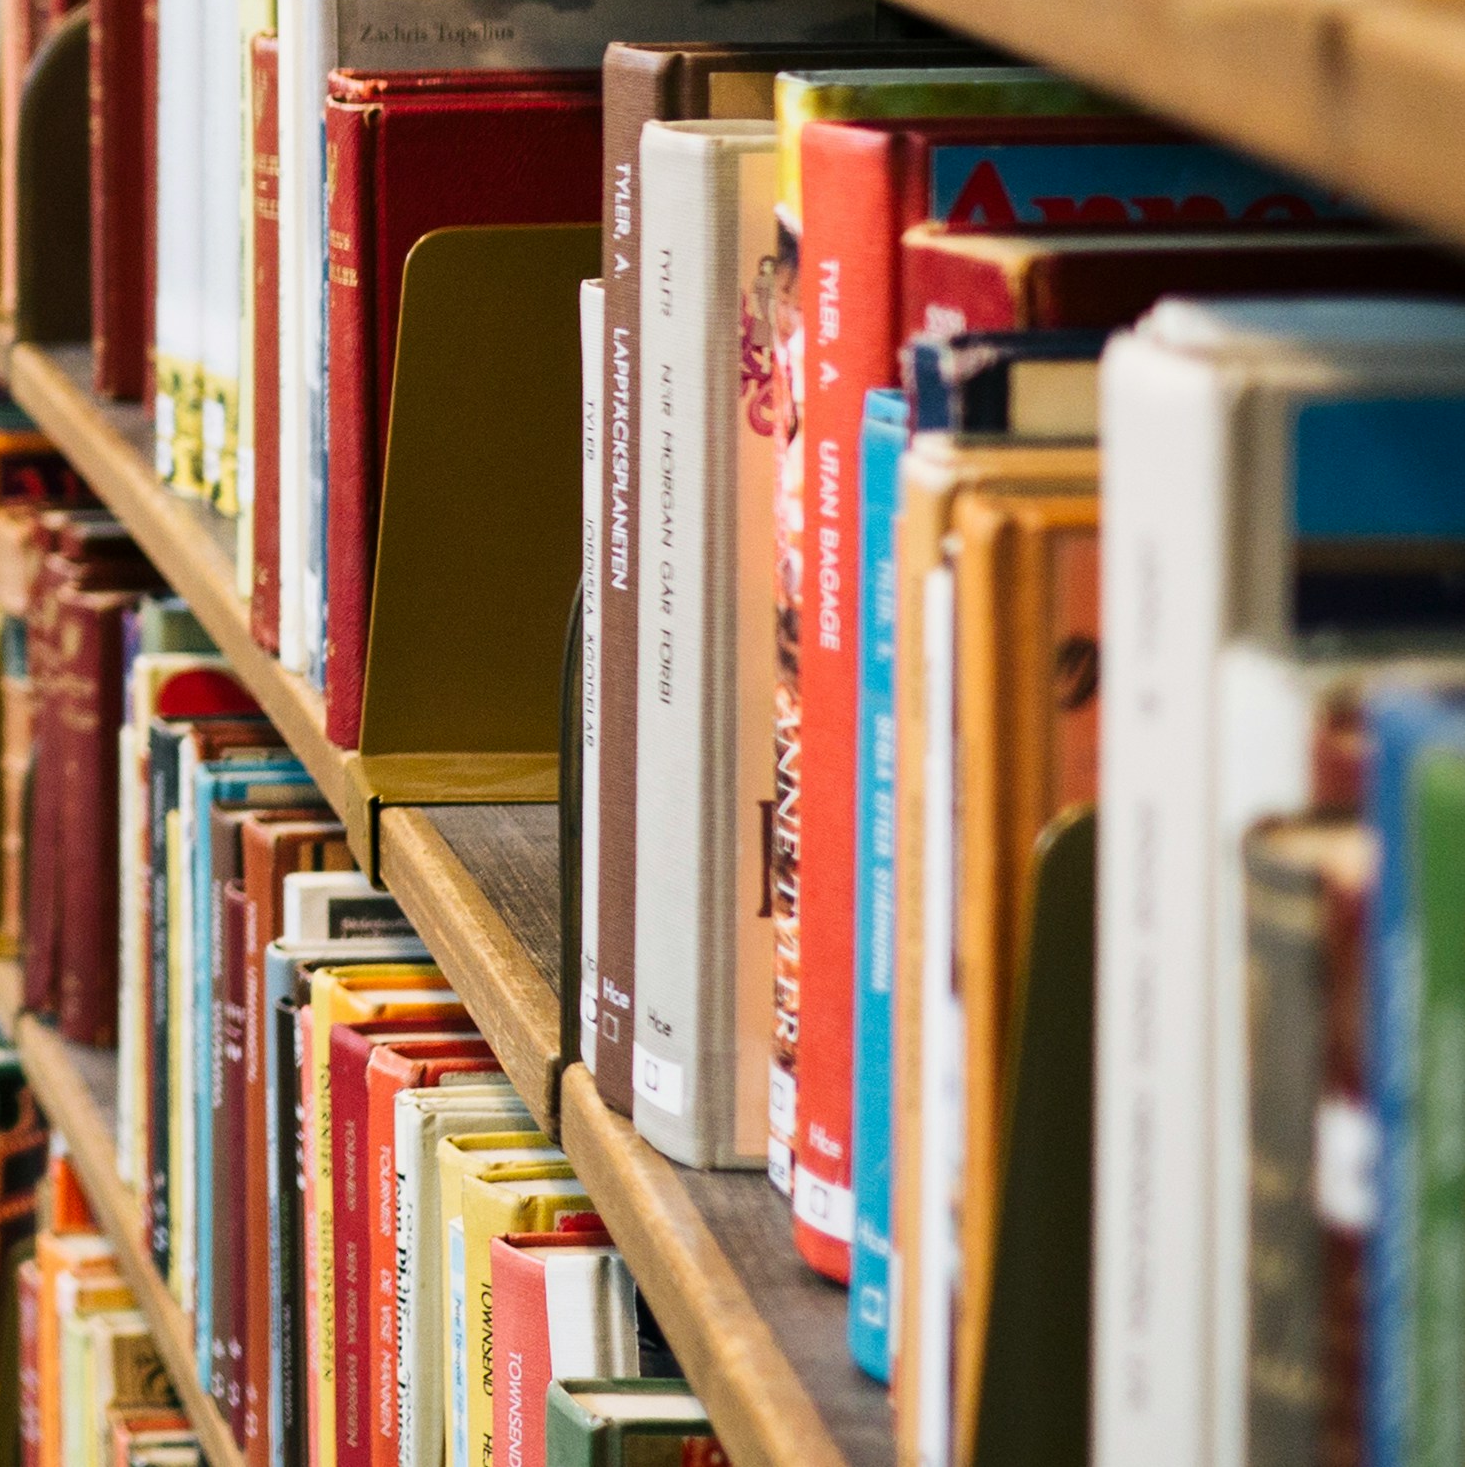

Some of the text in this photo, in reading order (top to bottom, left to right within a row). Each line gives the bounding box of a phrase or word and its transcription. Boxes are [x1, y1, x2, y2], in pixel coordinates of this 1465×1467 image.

[359, 23, 514, 48] Zachris Topelius
[817, 259, 841, 346] TYLER,
[610, 162, 632, 592] TYLER, A. LAPPTÄCKSPLANETEN
[659, 429, 674, 548] MORGAN
[818, 440, 840, 518] UTAN
[659, 561, 674, 616] GÅR
[818, 527, 841, 652] BAGAGE
[659, 627, 674, 704] FÖRBI
[774, 688, 801, 1044] ANNE TYLER
[602, 976, 630, 1010] Hce
[379, 1144, 392, 1237] TOURNIER
[379, 1268, 393, 1297] DE
[481, 1282, 493, 1397] TOWNSEND
[507, 1350, 524, 1467] TOWNSEND
